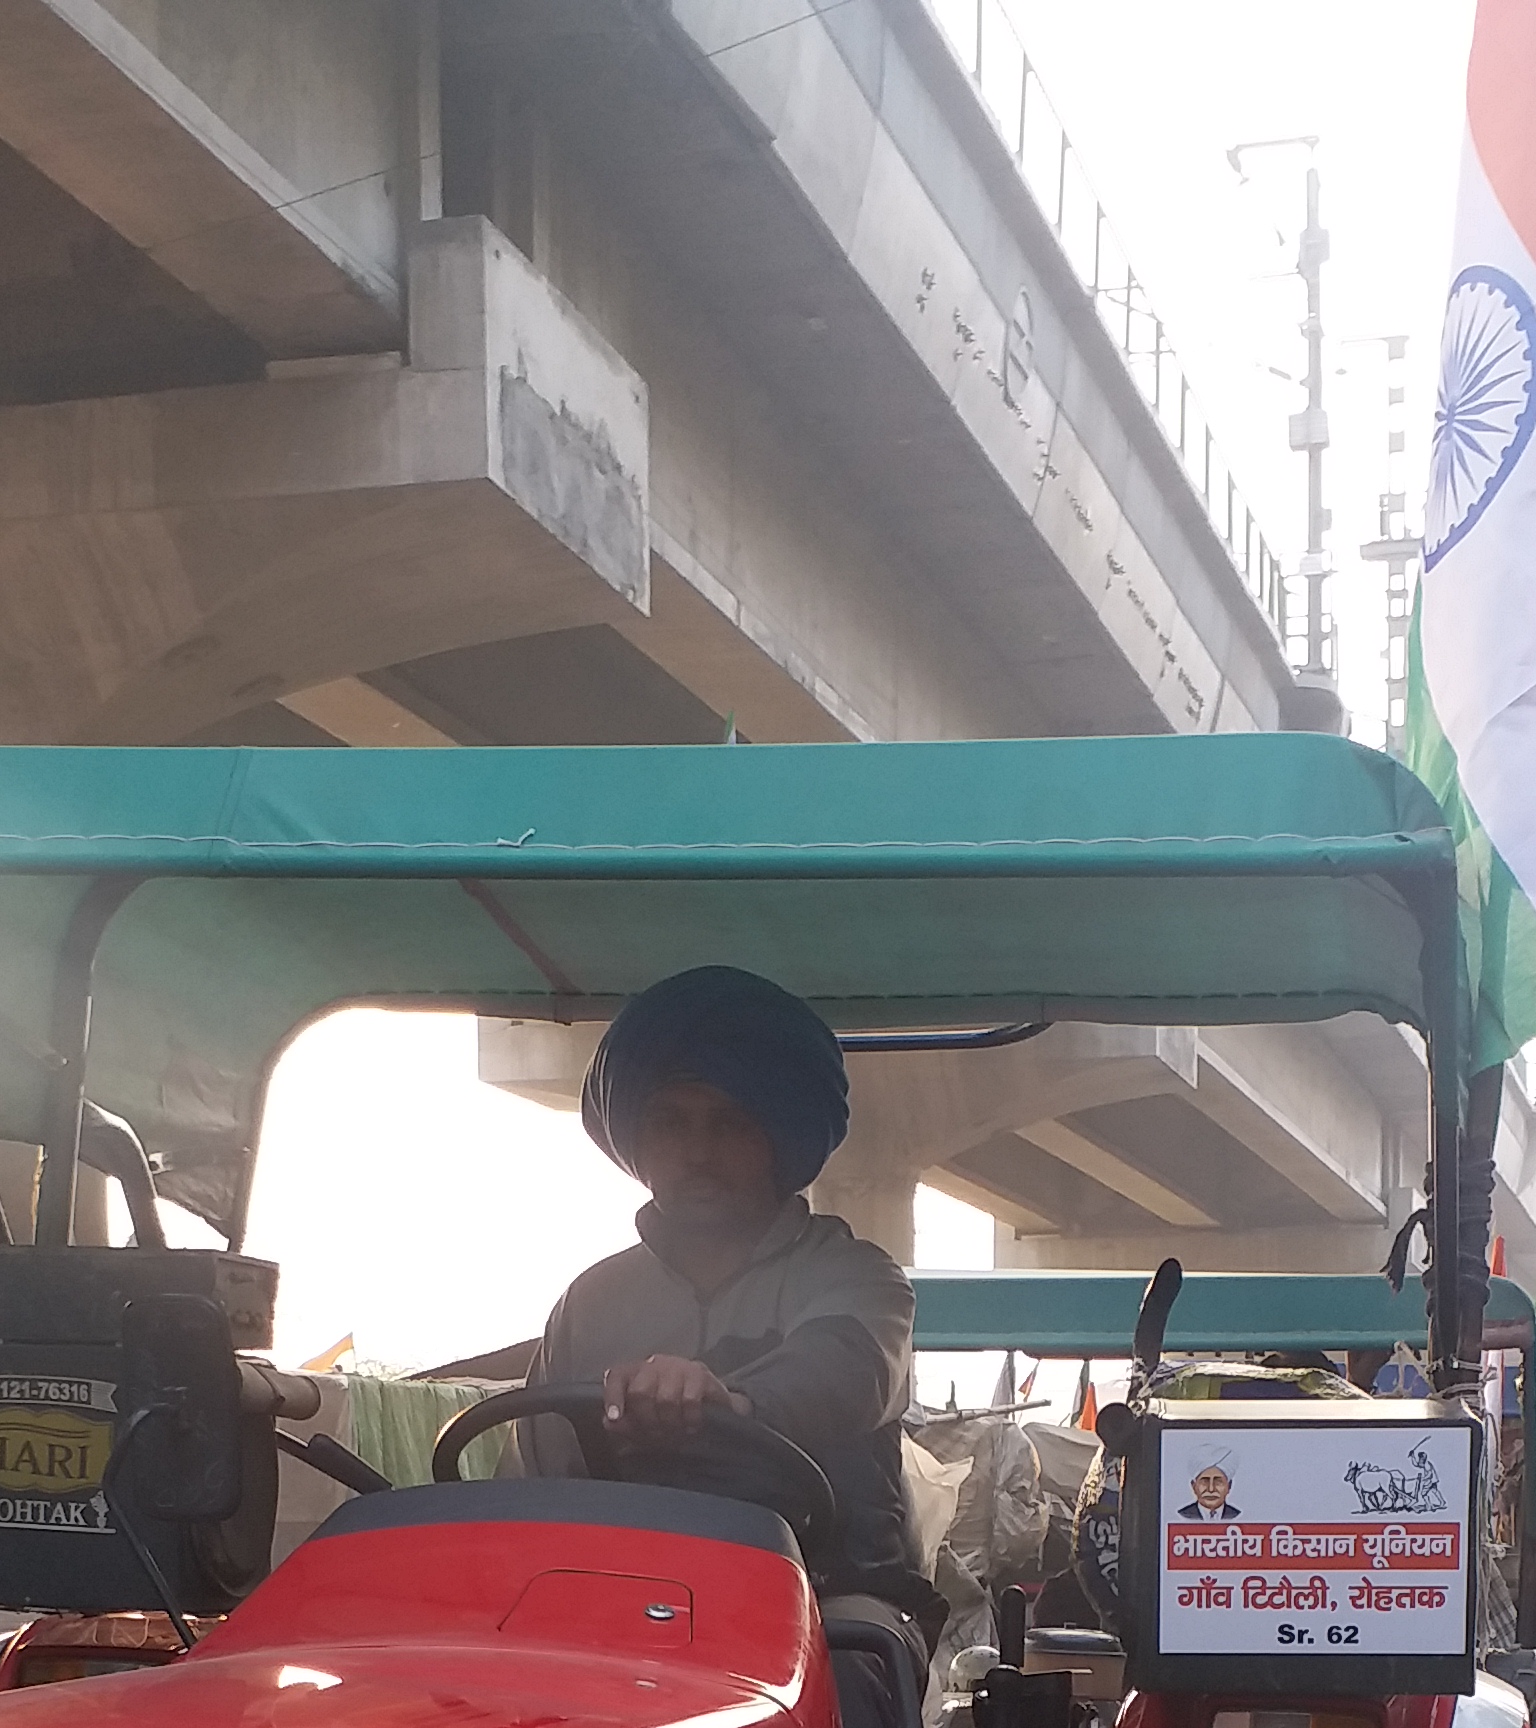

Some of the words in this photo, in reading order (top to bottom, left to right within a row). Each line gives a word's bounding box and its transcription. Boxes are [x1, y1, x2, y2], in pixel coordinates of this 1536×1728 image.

[1172, 1525, 1263, 1558] भारतीय
[1269, 1525, 1355, 1557] किसान
[1362, 1525, 1453, 1568] यूनियन
[1177, 1575, 1234, 1609] गाँव
[1241, 1575, 1338, 1612] टिटौली,
[1348, 1577, 1449, 1610] रोहतक
[1277, 1624, 1314, 1645] Sr.
[1327, 1624, 1359, 1645] 62
